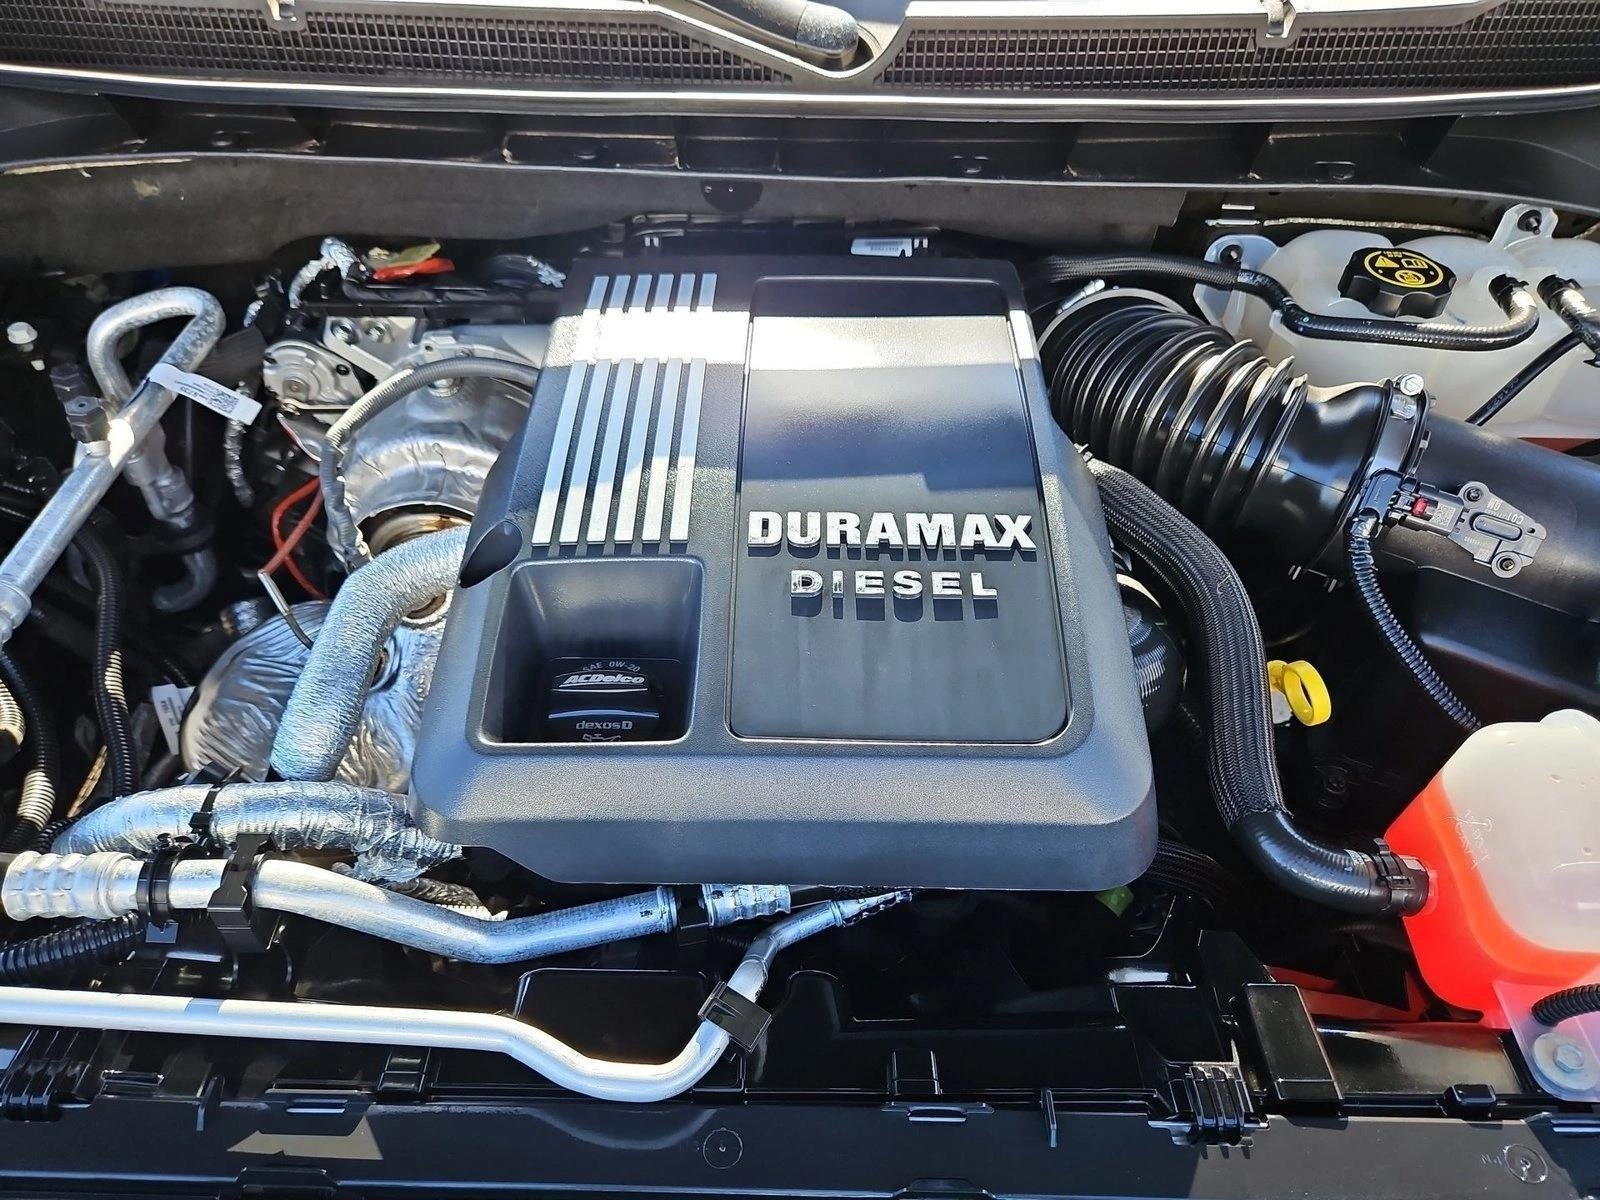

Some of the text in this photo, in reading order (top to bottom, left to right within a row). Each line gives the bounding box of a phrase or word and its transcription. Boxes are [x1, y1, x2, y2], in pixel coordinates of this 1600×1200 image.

[748, 511, 1037, 549] DURAMAX
[791, 570, 997, 598] DIESEL
[583, 660, 640, 672] SAE 0W-20
[563, 673, 645, 684] ACDelco
